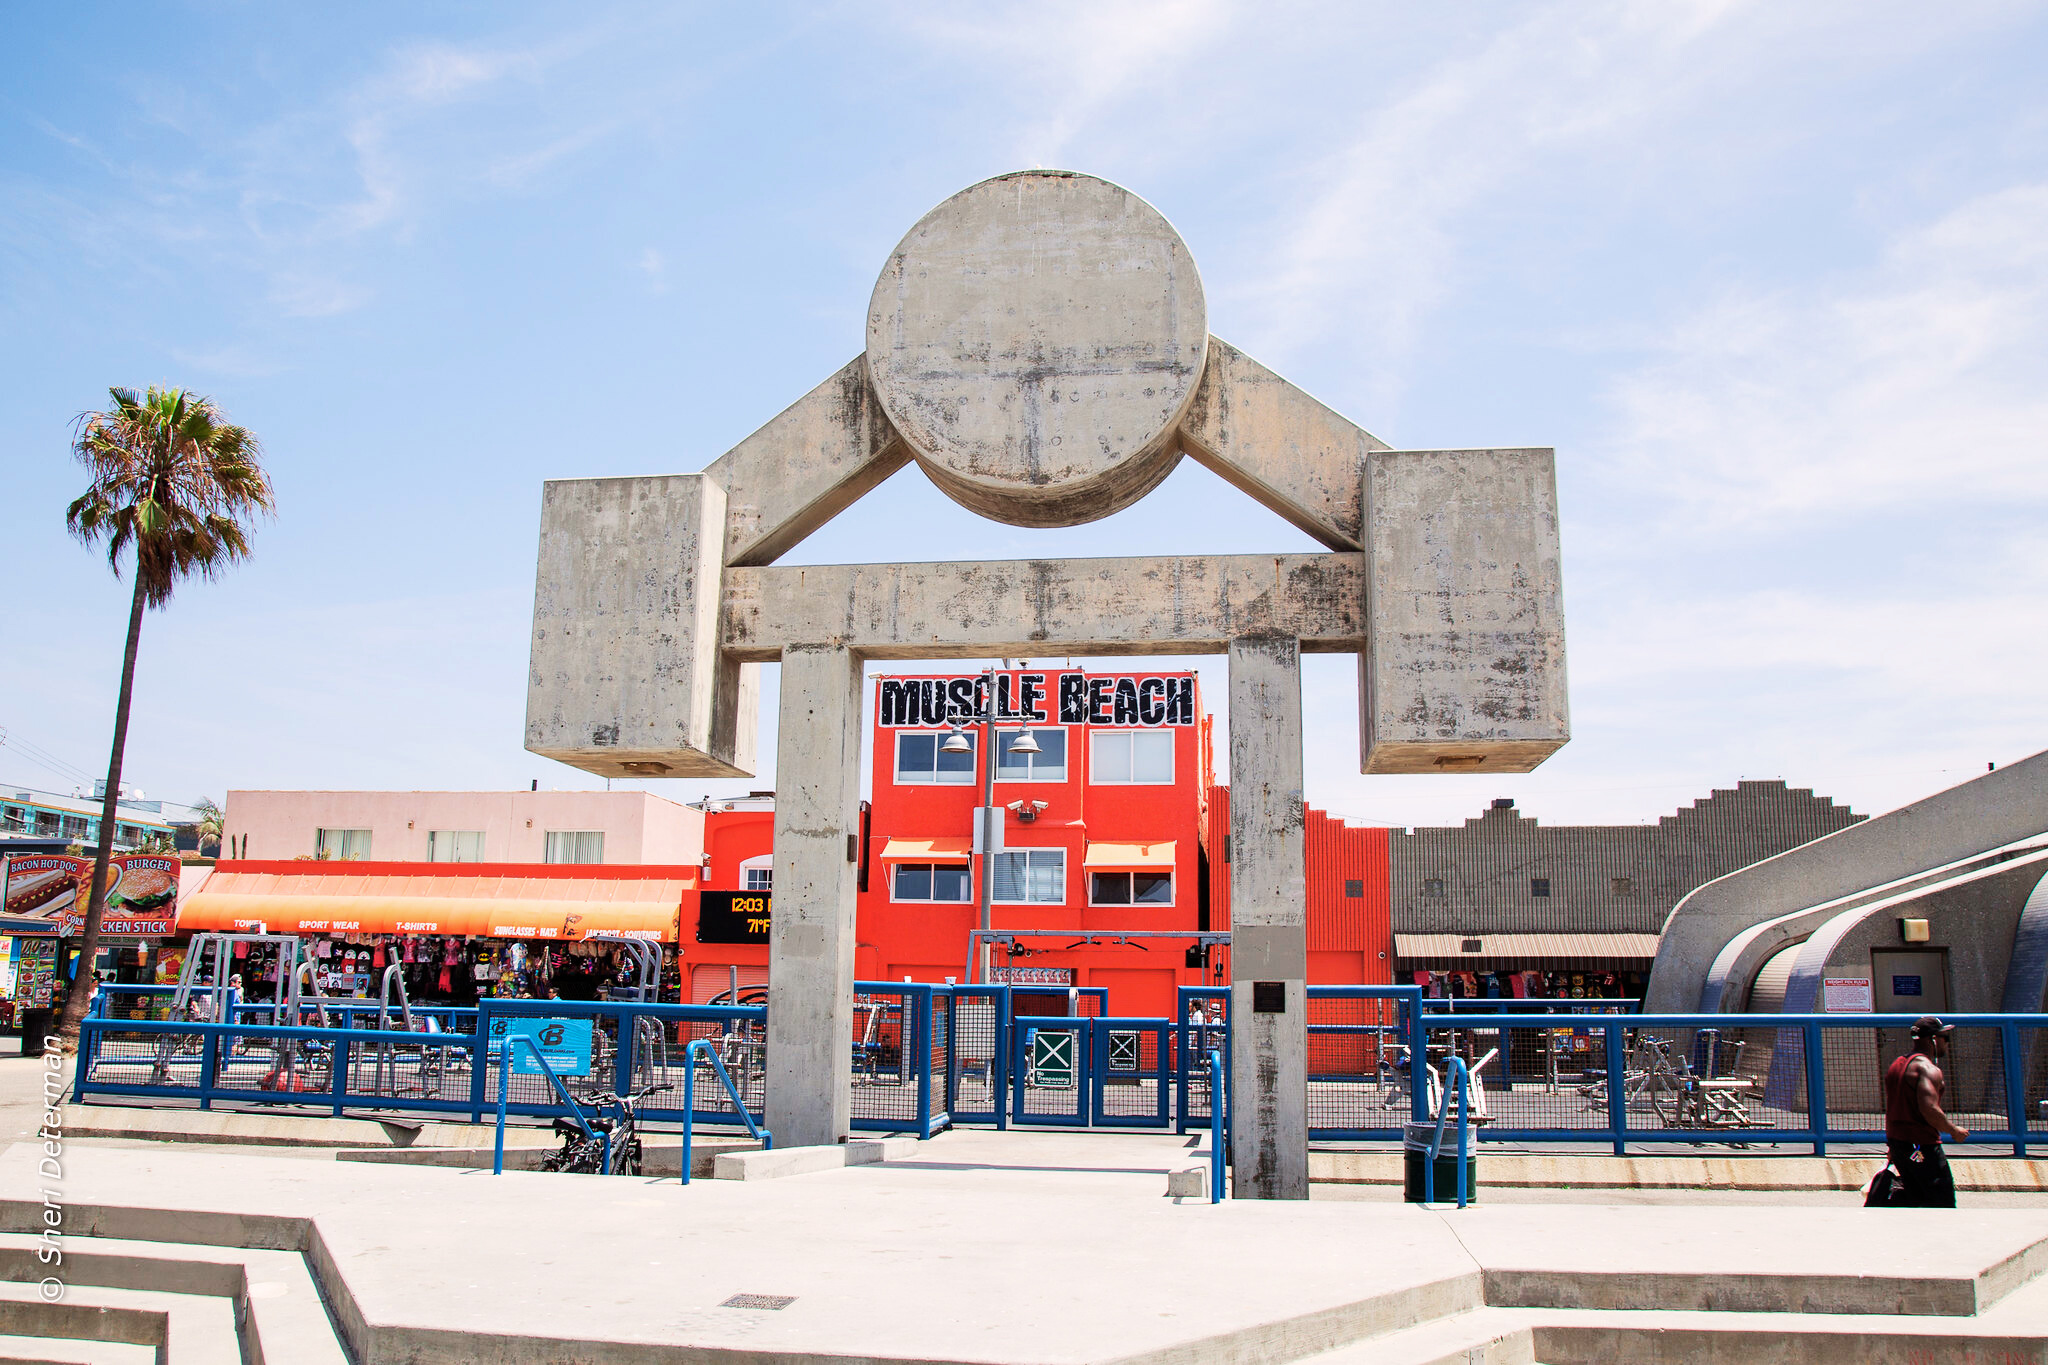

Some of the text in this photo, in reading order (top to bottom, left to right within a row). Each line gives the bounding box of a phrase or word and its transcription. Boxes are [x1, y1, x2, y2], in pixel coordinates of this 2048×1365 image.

[881, 673, 1194, 725] MUSCLE BEACH
[11, 859, 78, 872] BACON HOT DOG
[126, 858, 172, 872] BURGER
[731, 897, 764, 912] 12:03
[66, 913, 85, 926] CORN
[298, 920, 360, 930] SPORT WEAR
[100, 921, 167, 933] CKEN STICK
[396, 922, 437, 931] T-SHIRTS
[494, 926, 558, 937] SUNGLASSES HATS
[624, 929, 662, 940] SOUVENIRS
[1037, 1075, 1070, 1083] Trespassing
